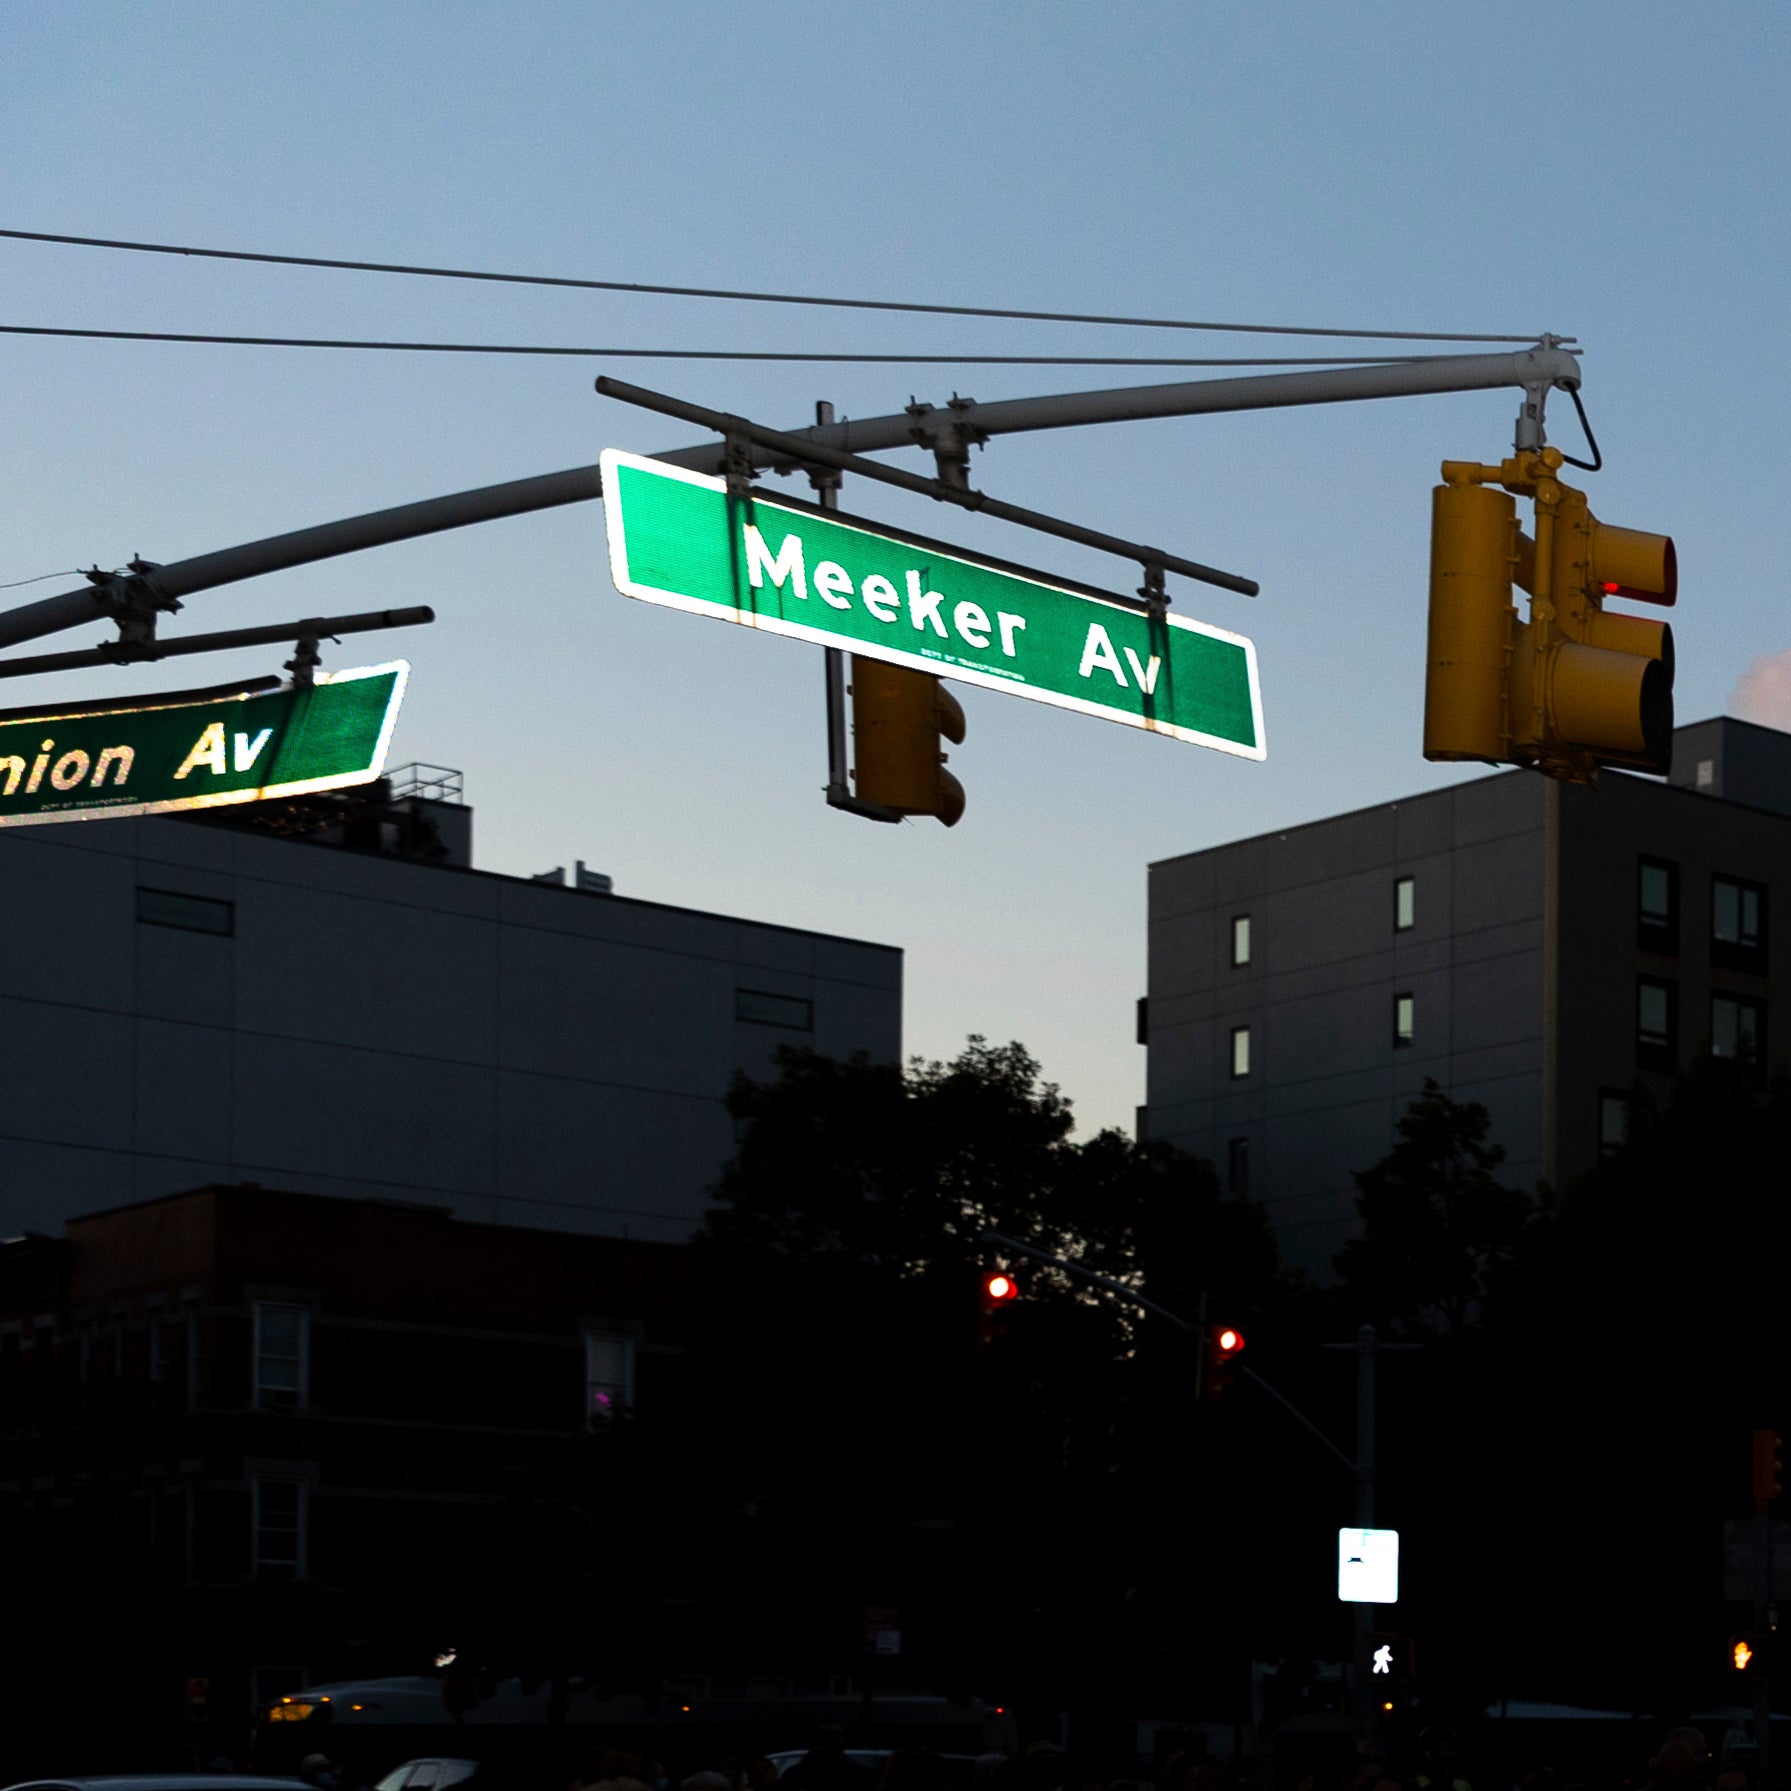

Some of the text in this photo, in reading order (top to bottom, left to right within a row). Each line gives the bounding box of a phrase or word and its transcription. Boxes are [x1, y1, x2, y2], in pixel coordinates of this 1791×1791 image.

[743, 523, 1162, 695] Meeker Av
[172, 721, 275, 780] Av
